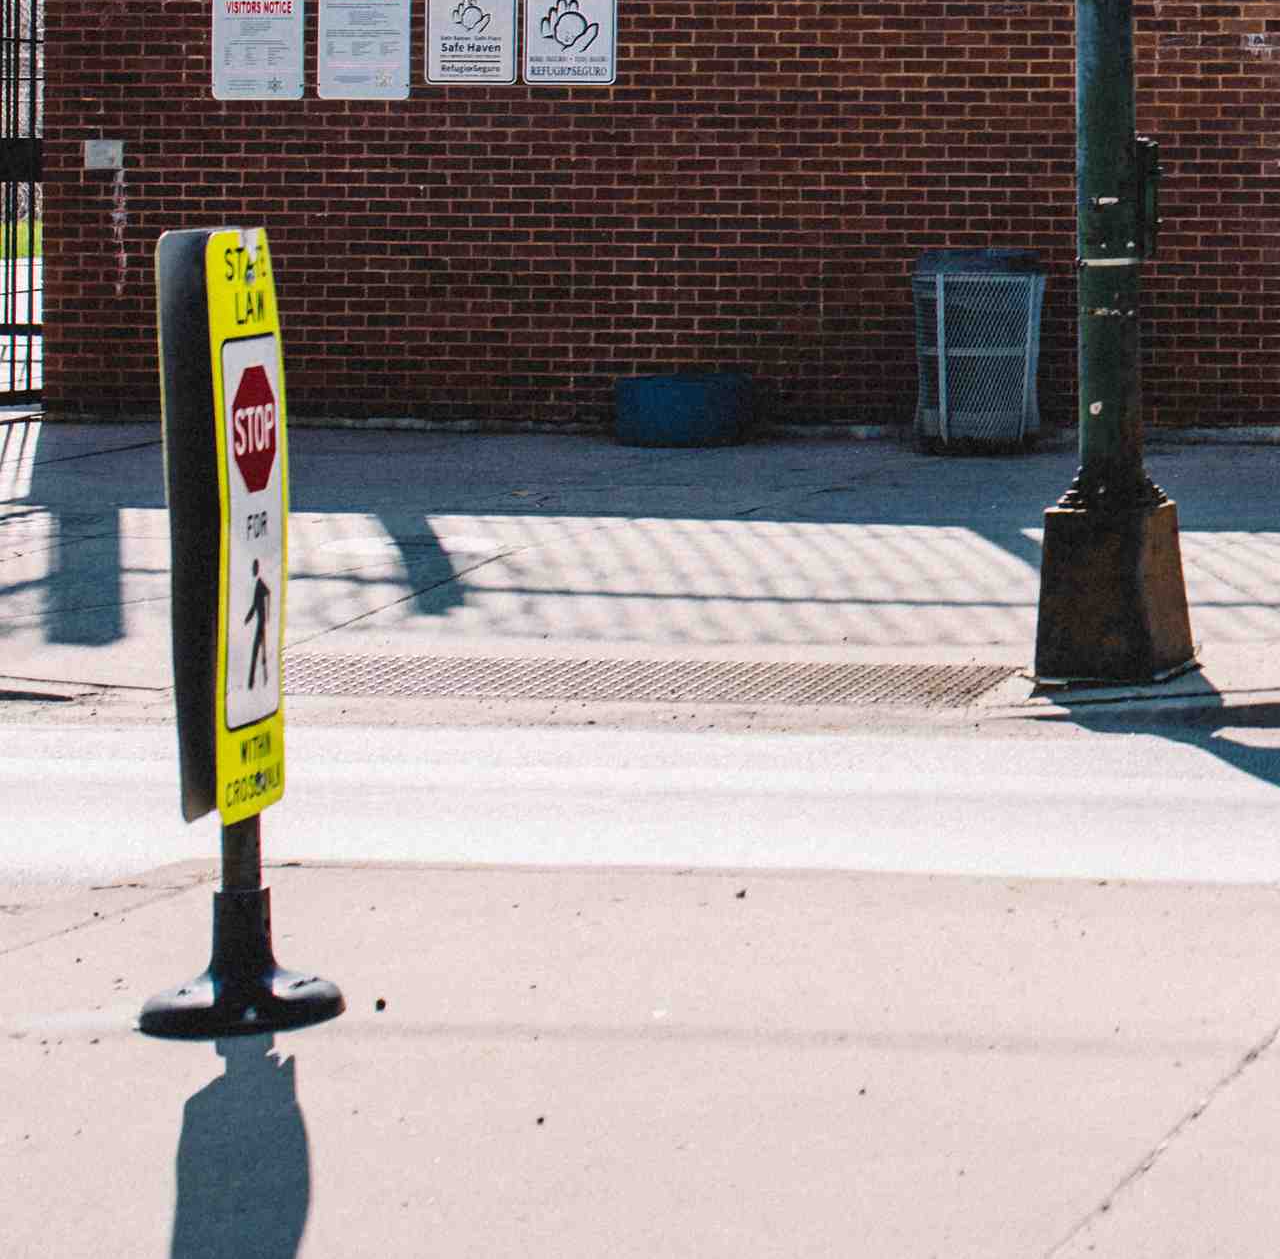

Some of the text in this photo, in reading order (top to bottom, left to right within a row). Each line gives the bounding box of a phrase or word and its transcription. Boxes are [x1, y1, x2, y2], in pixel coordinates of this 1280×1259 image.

[226, 1, 292, 14] VISITORS NOTICE
[441, 42, 502, 52] Safe Haven
[235, 291, 265, 324] LAW
[234, 403, 274, 456] STOP
[246, 510, 268, 541] FOR
